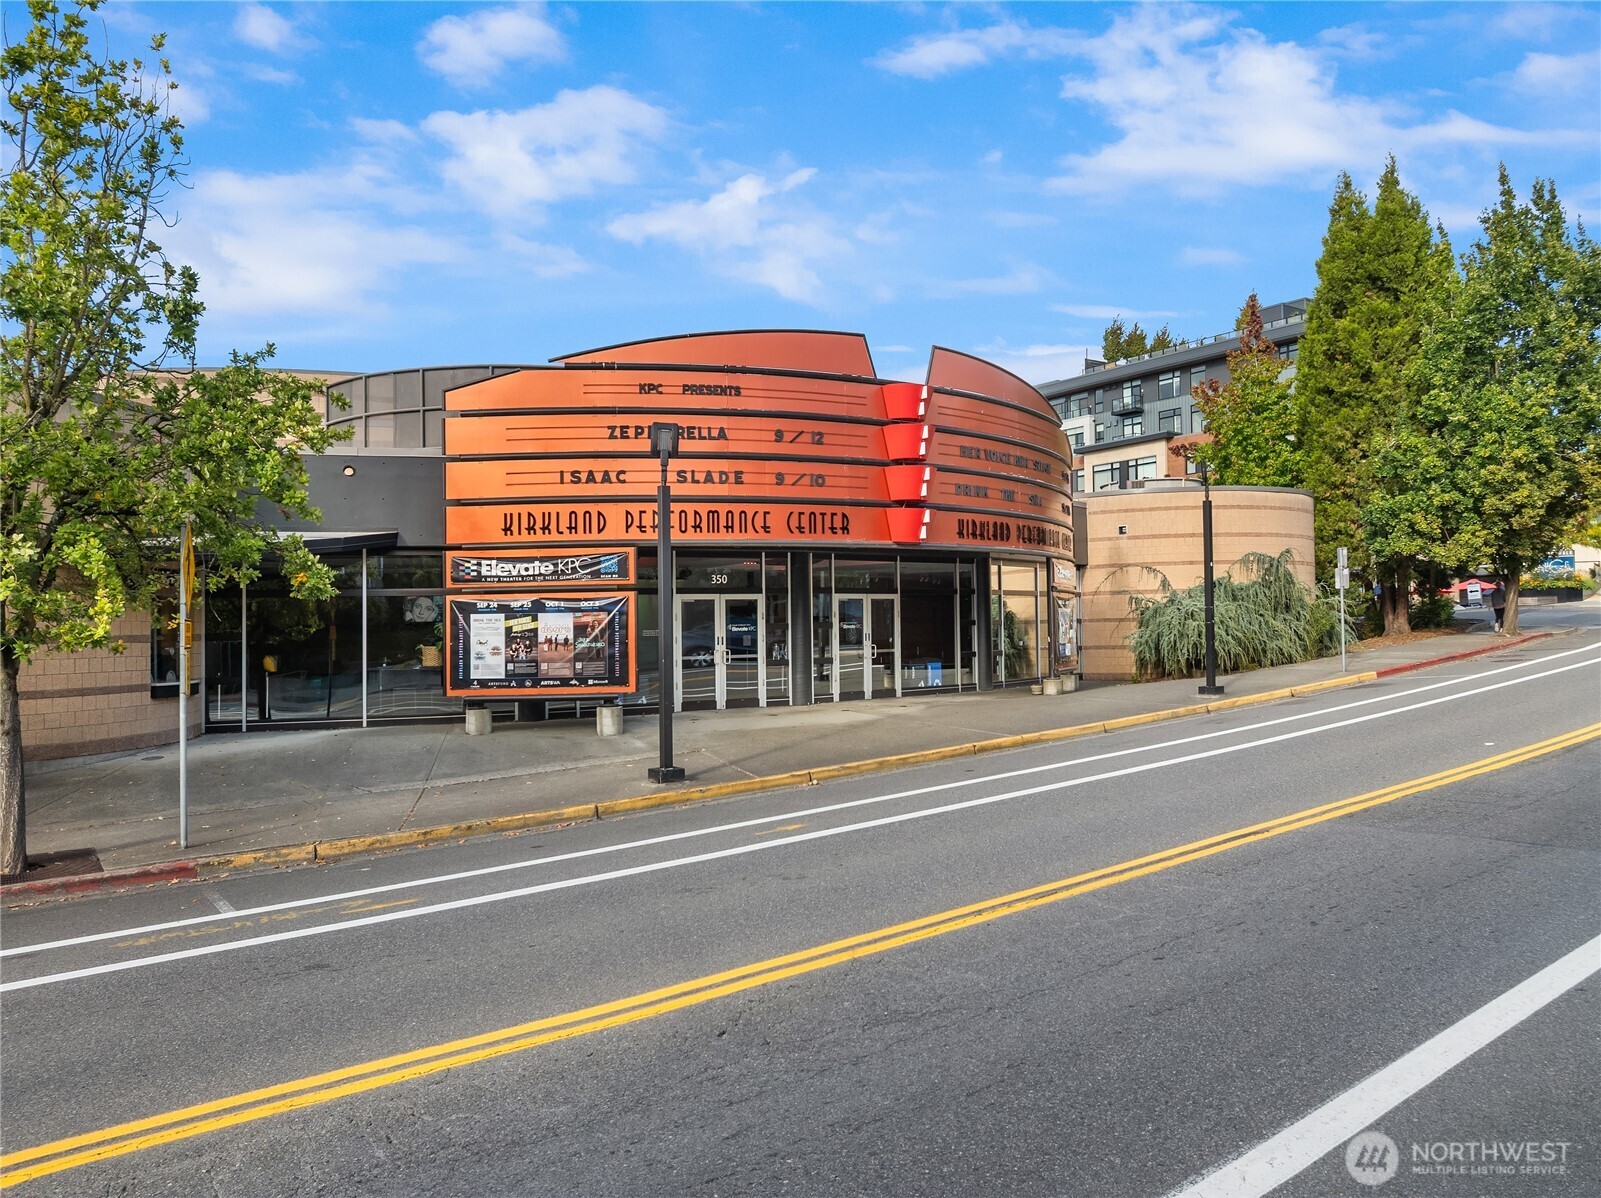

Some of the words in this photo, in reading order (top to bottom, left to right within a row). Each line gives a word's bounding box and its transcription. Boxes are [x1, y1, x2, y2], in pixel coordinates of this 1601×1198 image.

[639, 383, 663, 394] KPC
[682, 384, 742, 396] PRESENTS
[607, 425, 728, 440] ZEPRELLA
[559, 469, 627, 485] ISAAC
[676, 470, 744, 485] SLADE
[501, 510, 607, 536] KIRKLAND
[786, 511, 850, 535] CENTER
[957, 519, 1011, 542] KIRKLAND
[481, 560, 554, 576] Elevate
[558, 558, 591, 574] KPC
[711, 575, 727, 584] 350
